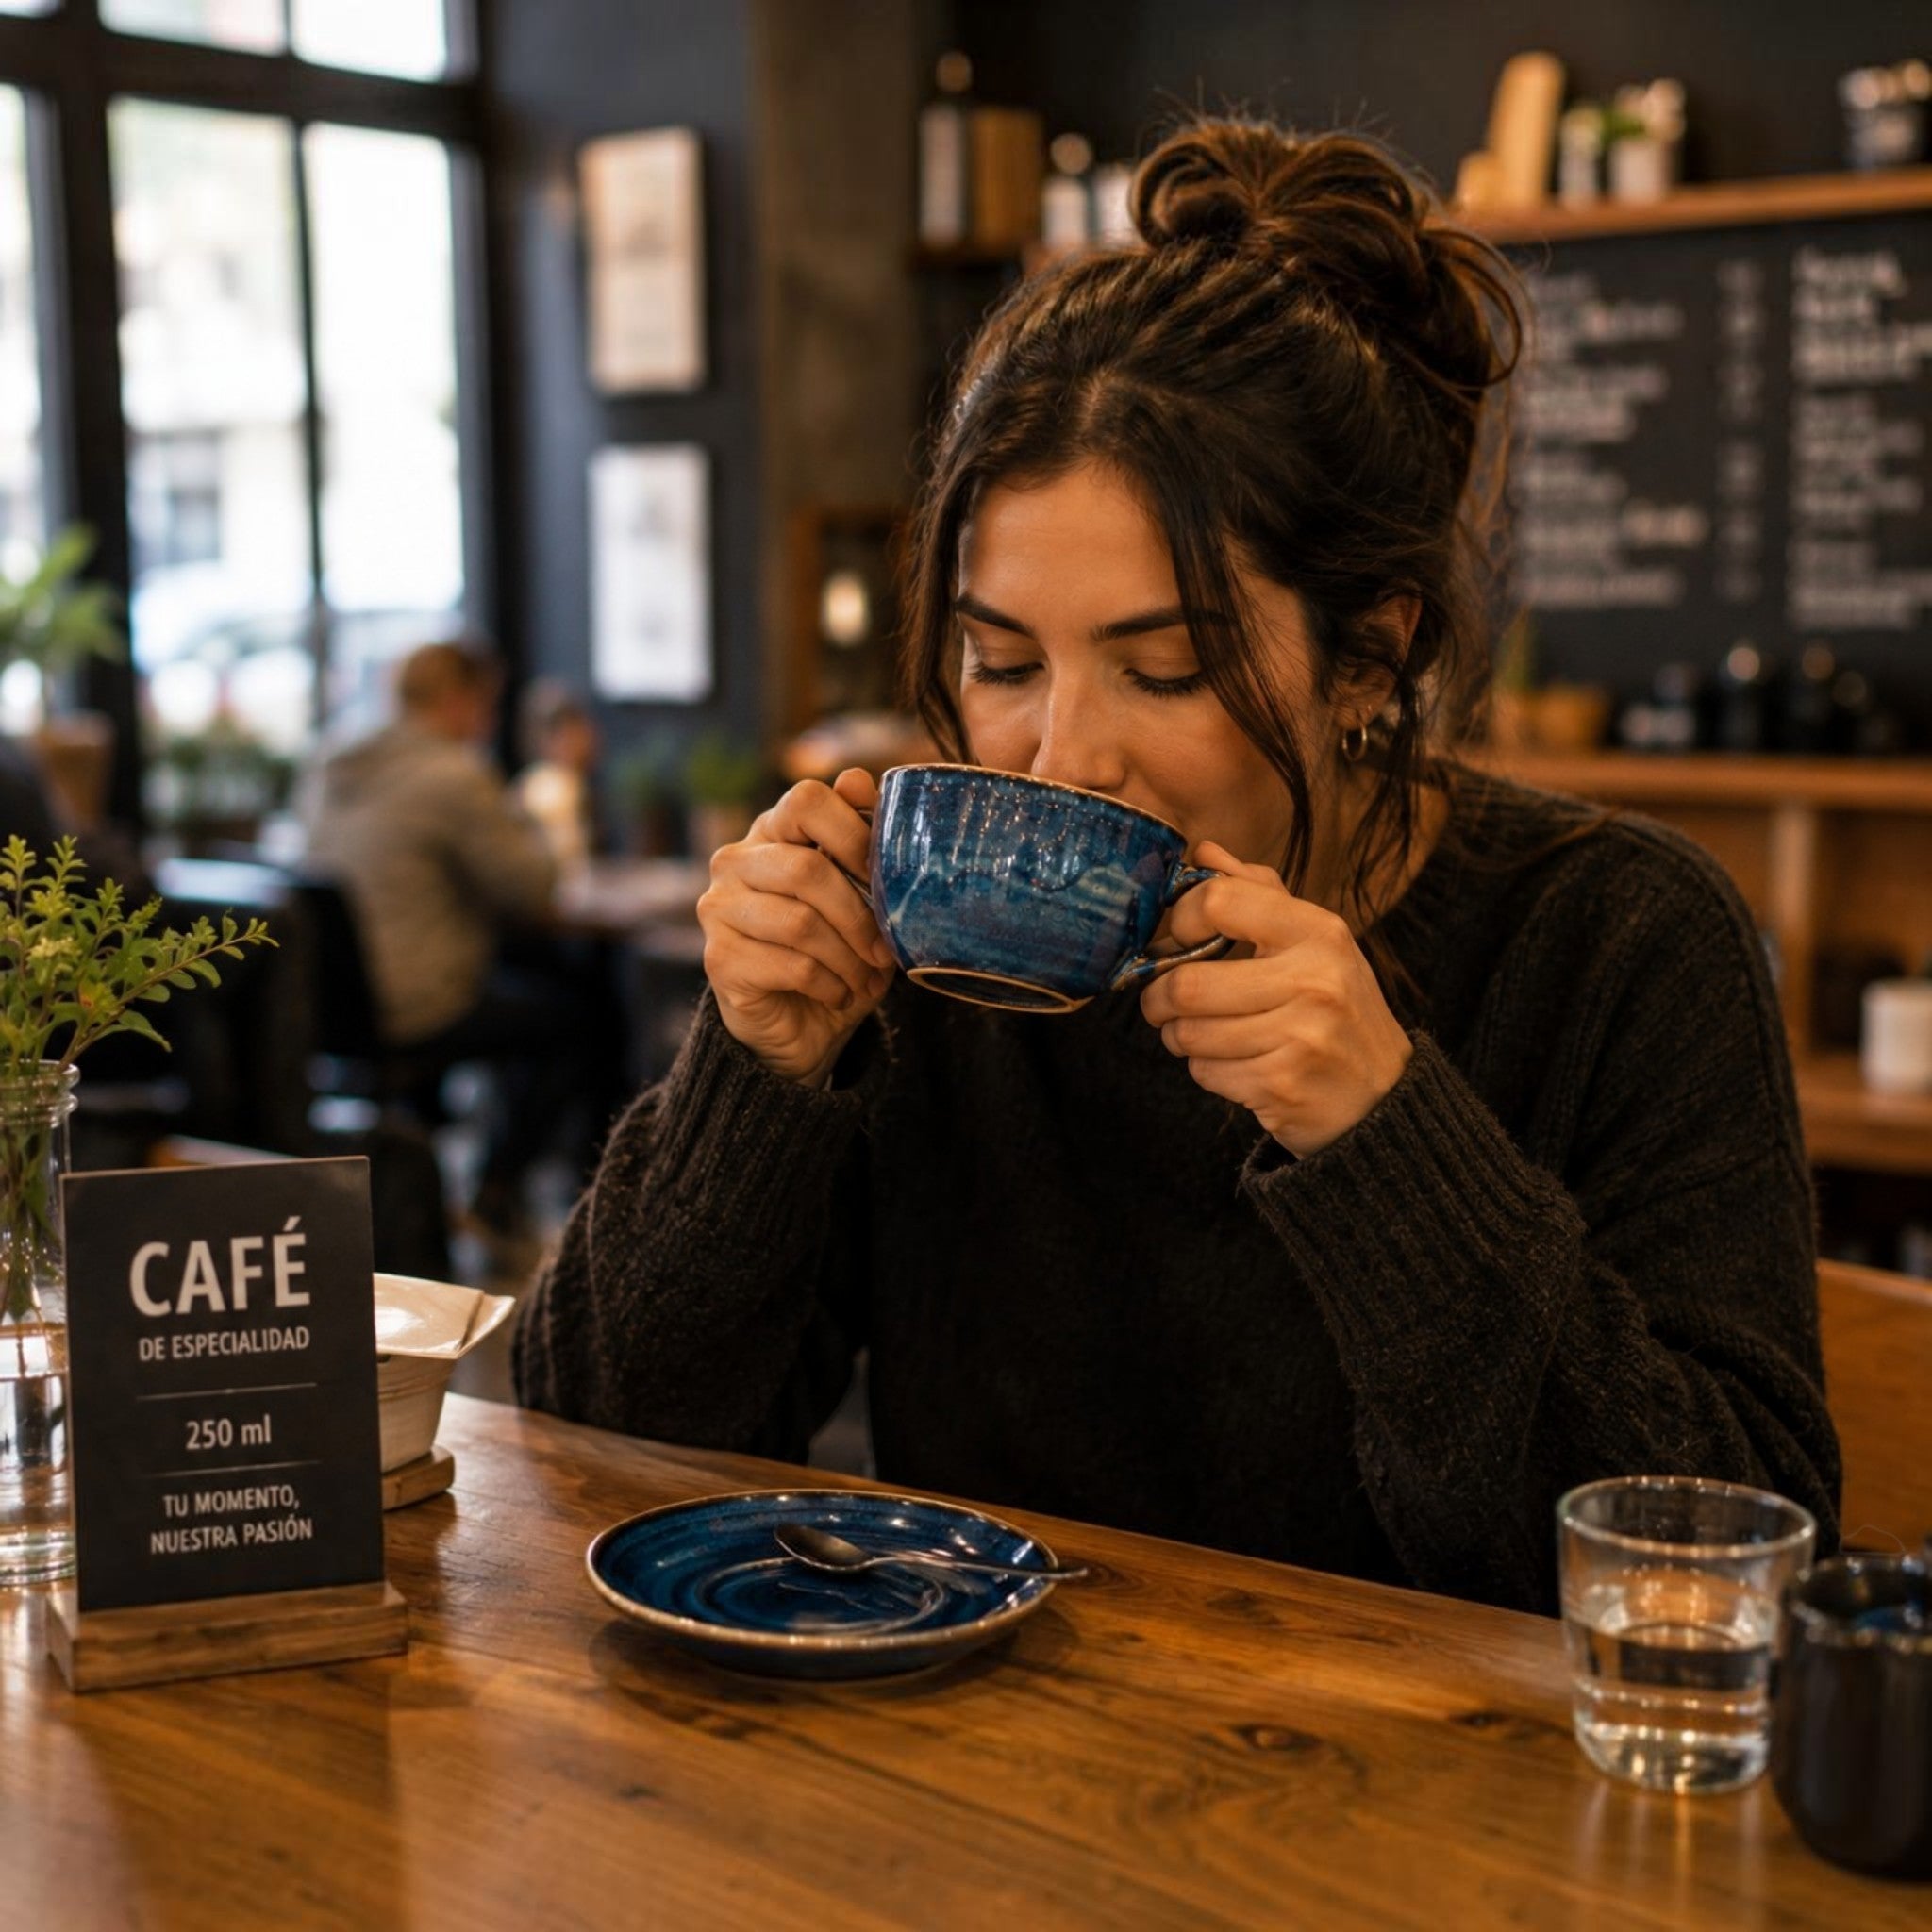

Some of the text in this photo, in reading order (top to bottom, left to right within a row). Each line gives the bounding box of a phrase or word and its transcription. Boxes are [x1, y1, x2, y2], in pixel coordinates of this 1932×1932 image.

[129, 1215, 310, 1317] CAFÉ
[139, 1326, 310, 1361] DE ESPECIALIDAD
[186, 1414, 272, 1450] 250 ml
[163, 1485, 300, 1517] TU MOMENTO,
[151, 1514, 313, 1554] NUESTRA PASIÓN
